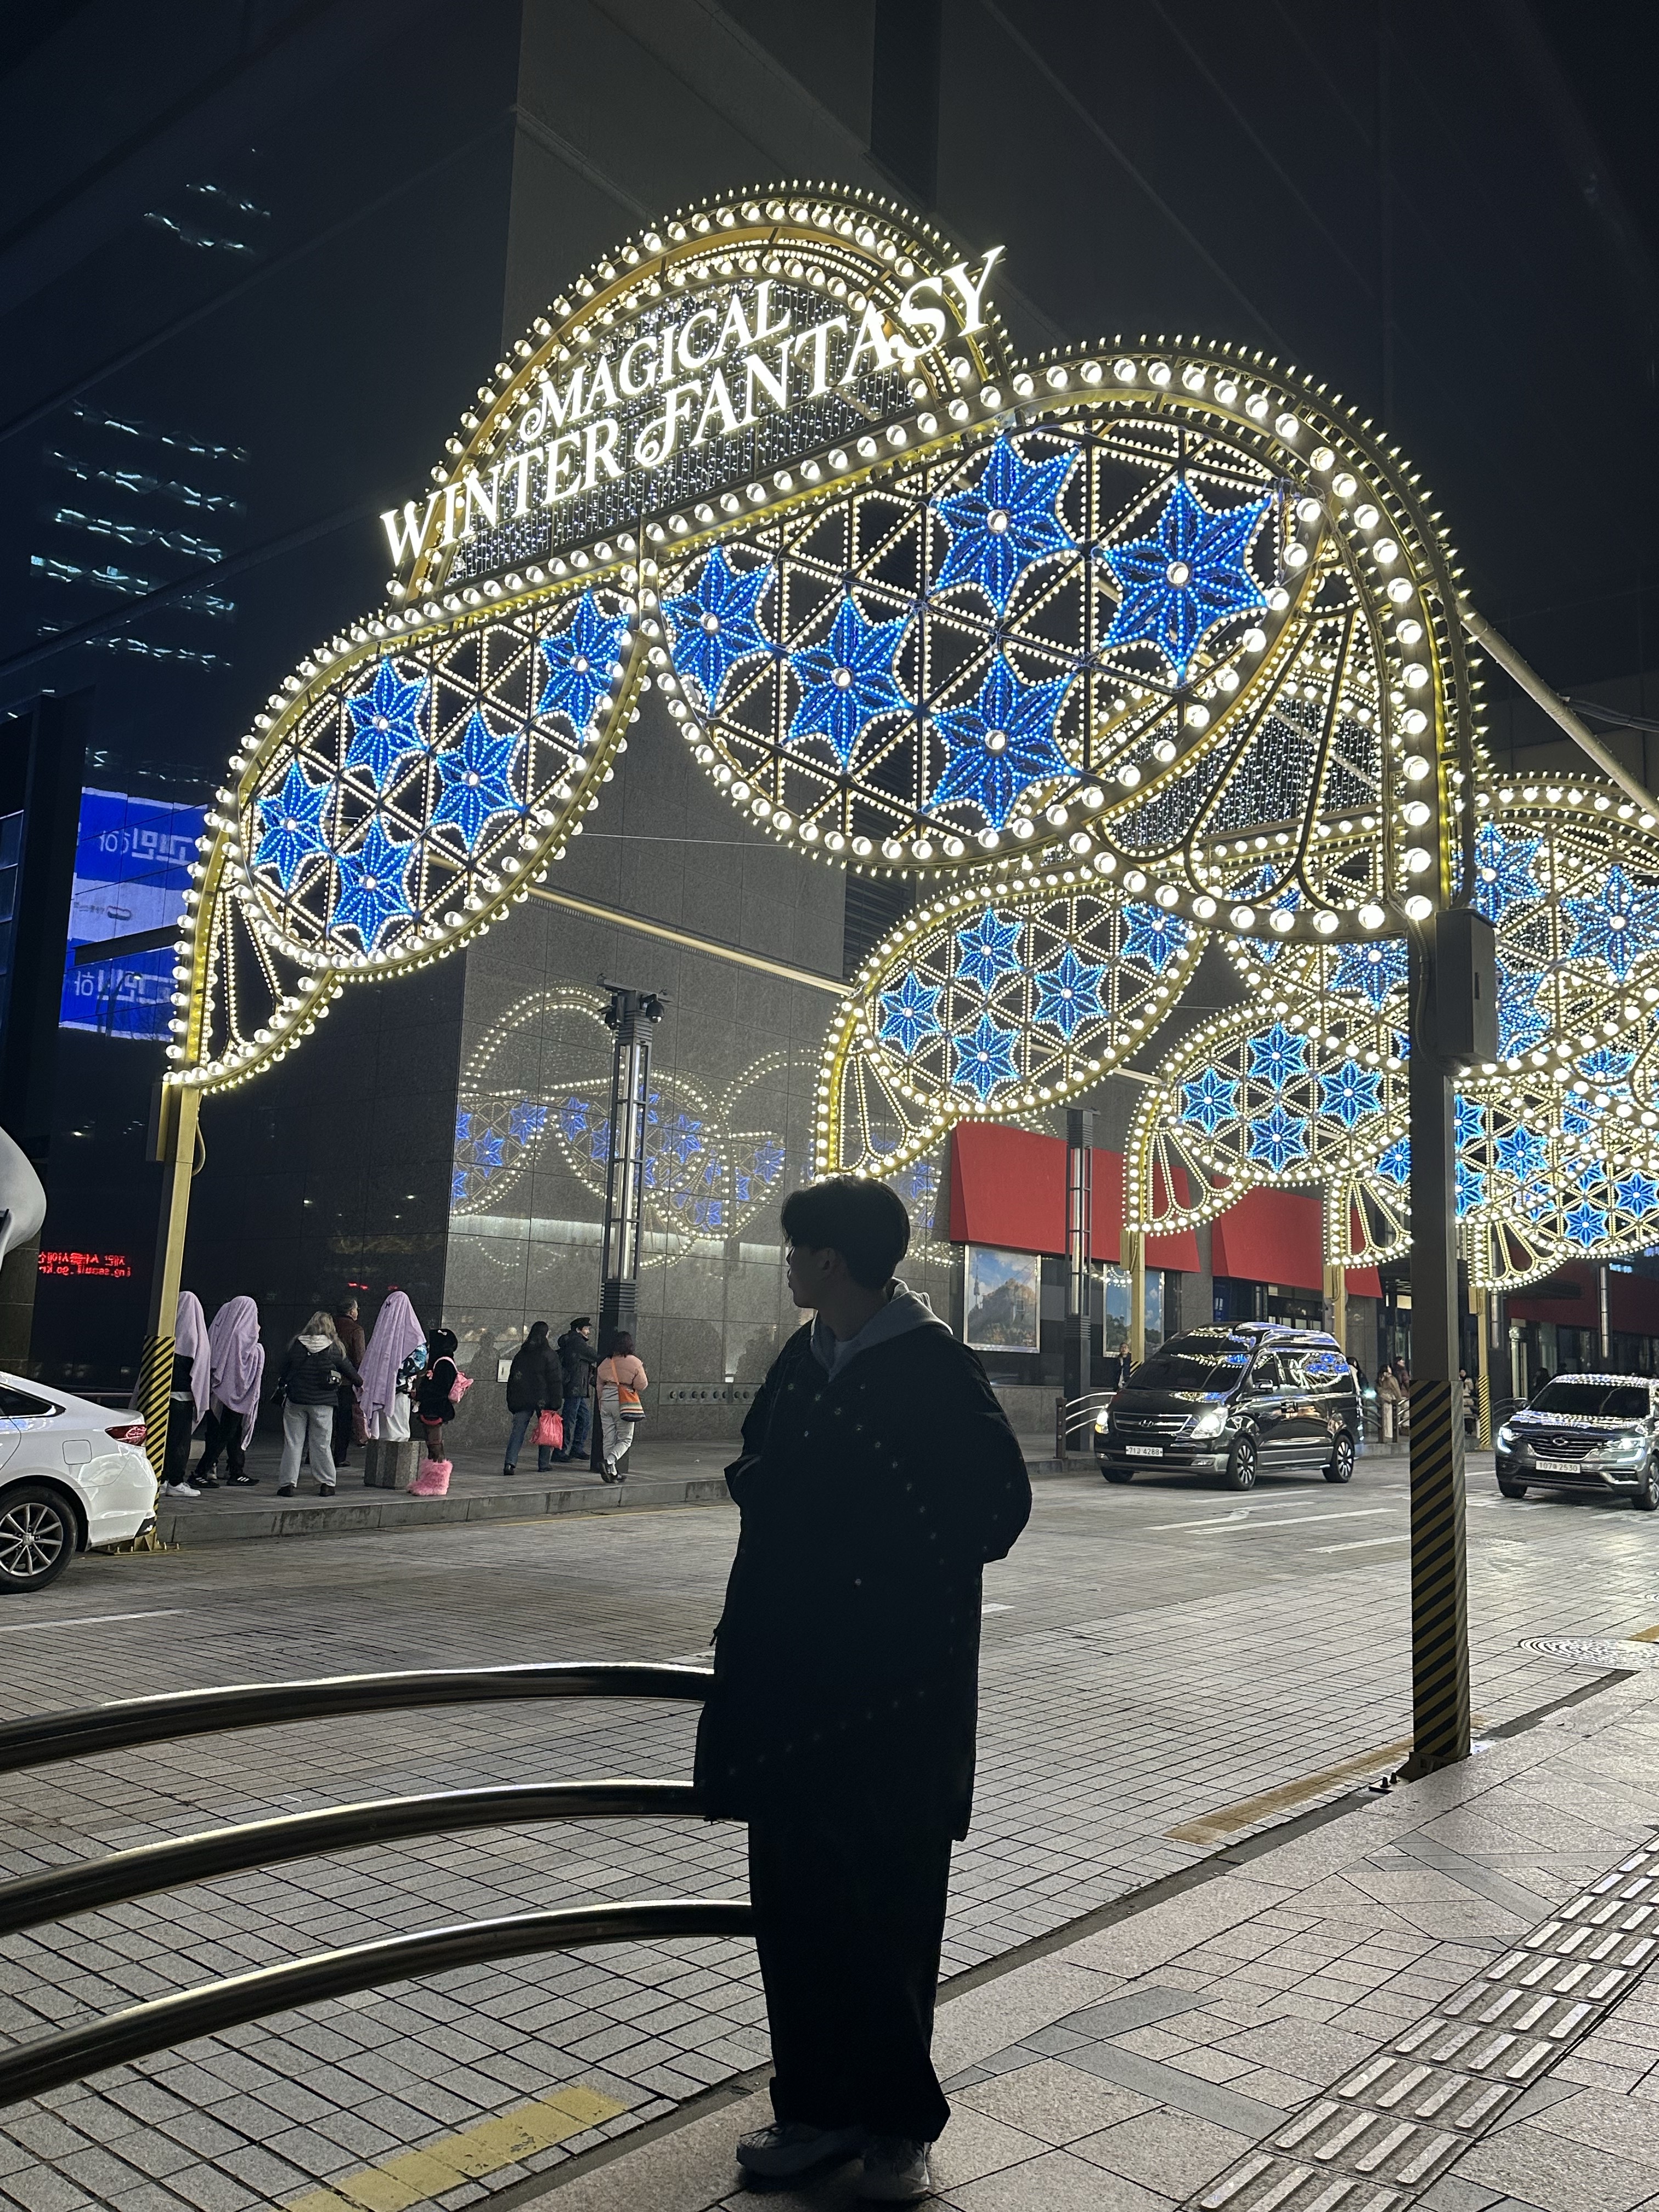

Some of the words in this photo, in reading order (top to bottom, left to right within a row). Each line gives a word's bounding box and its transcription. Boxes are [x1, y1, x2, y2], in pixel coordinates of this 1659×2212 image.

[379, 419, 624, 567] WINTER
[633, 245, 1007, 467] FANTASY
[518, 279, 792, 441] MAGICAL
[1559, 1463, 1578, 1472] 2530
